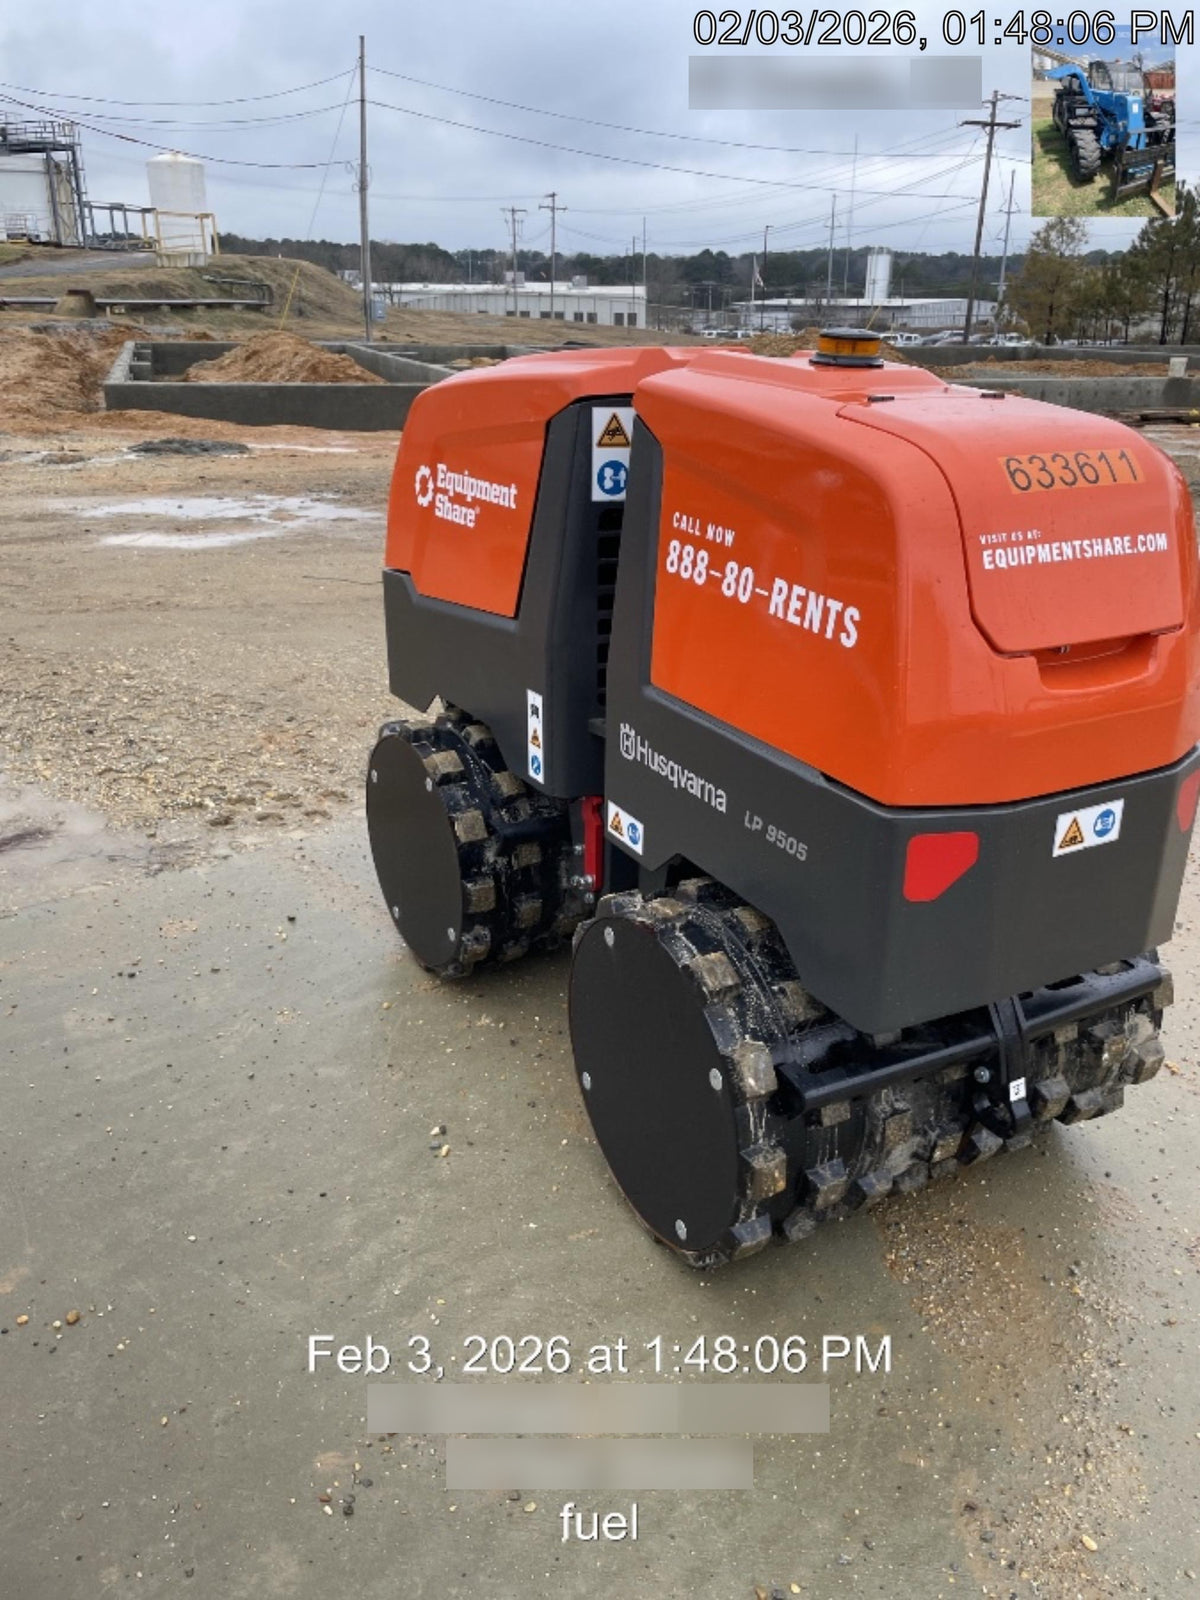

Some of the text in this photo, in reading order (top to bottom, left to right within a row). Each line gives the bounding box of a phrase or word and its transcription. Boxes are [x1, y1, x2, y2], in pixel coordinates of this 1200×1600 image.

[436, 463, 518, 509] Equipment
[1005, 450, 1138, 492] 633611
[673, 511, 736, 547] CALL NOW
[979, 532, 1008, 545] VISIT
[981, 532, 1168, 570] EQUIPMENTSHARE.COM
[666, 539, 861, 648] 888-80-RENTS
[636, 735, 809, 862] Husqvarna LP 9505
